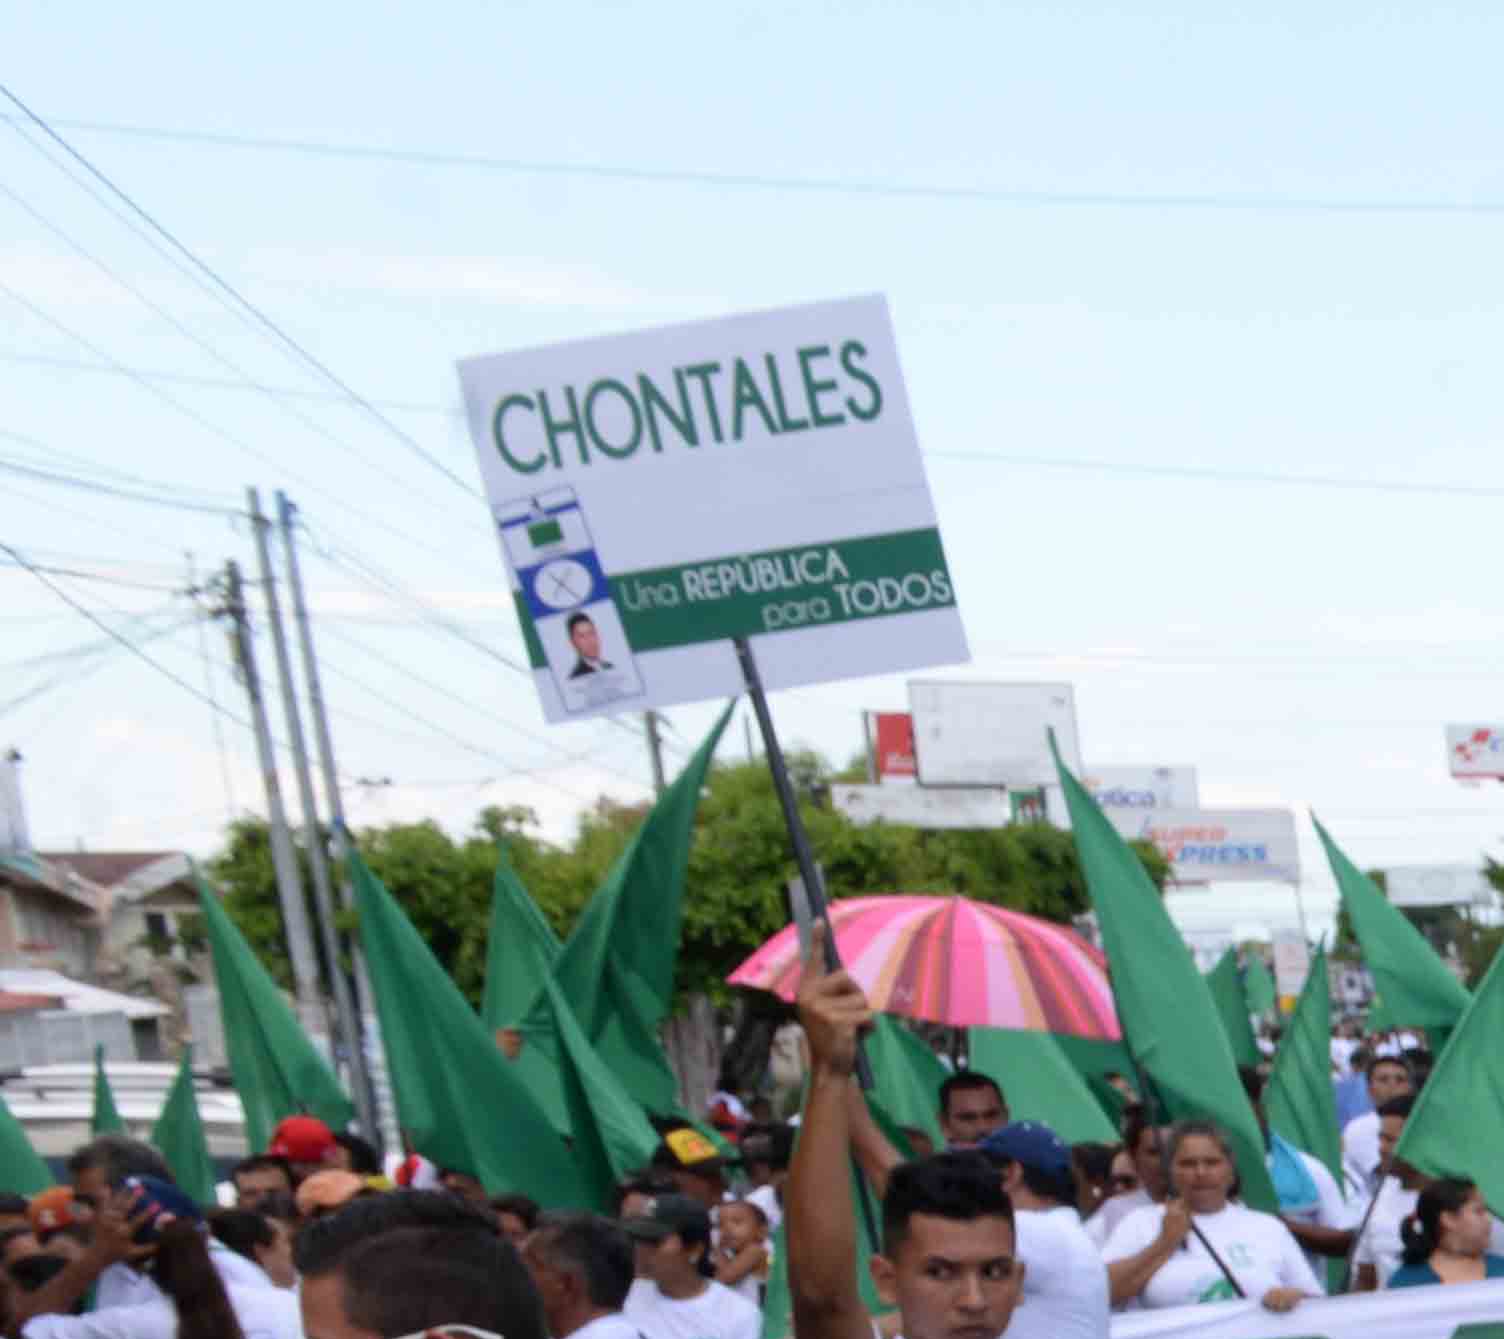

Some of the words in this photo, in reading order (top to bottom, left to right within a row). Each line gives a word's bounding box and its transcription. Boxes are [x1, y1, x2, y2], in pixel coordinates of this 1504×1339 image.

[493, 340, 883, 475] CHONTALES
[621, 580, 680, 611] Una
[681, 549, 848, 602] REPÚBLICA
[761, 598, 831, 629] para
[833, 570, 950, 614] TODOS
